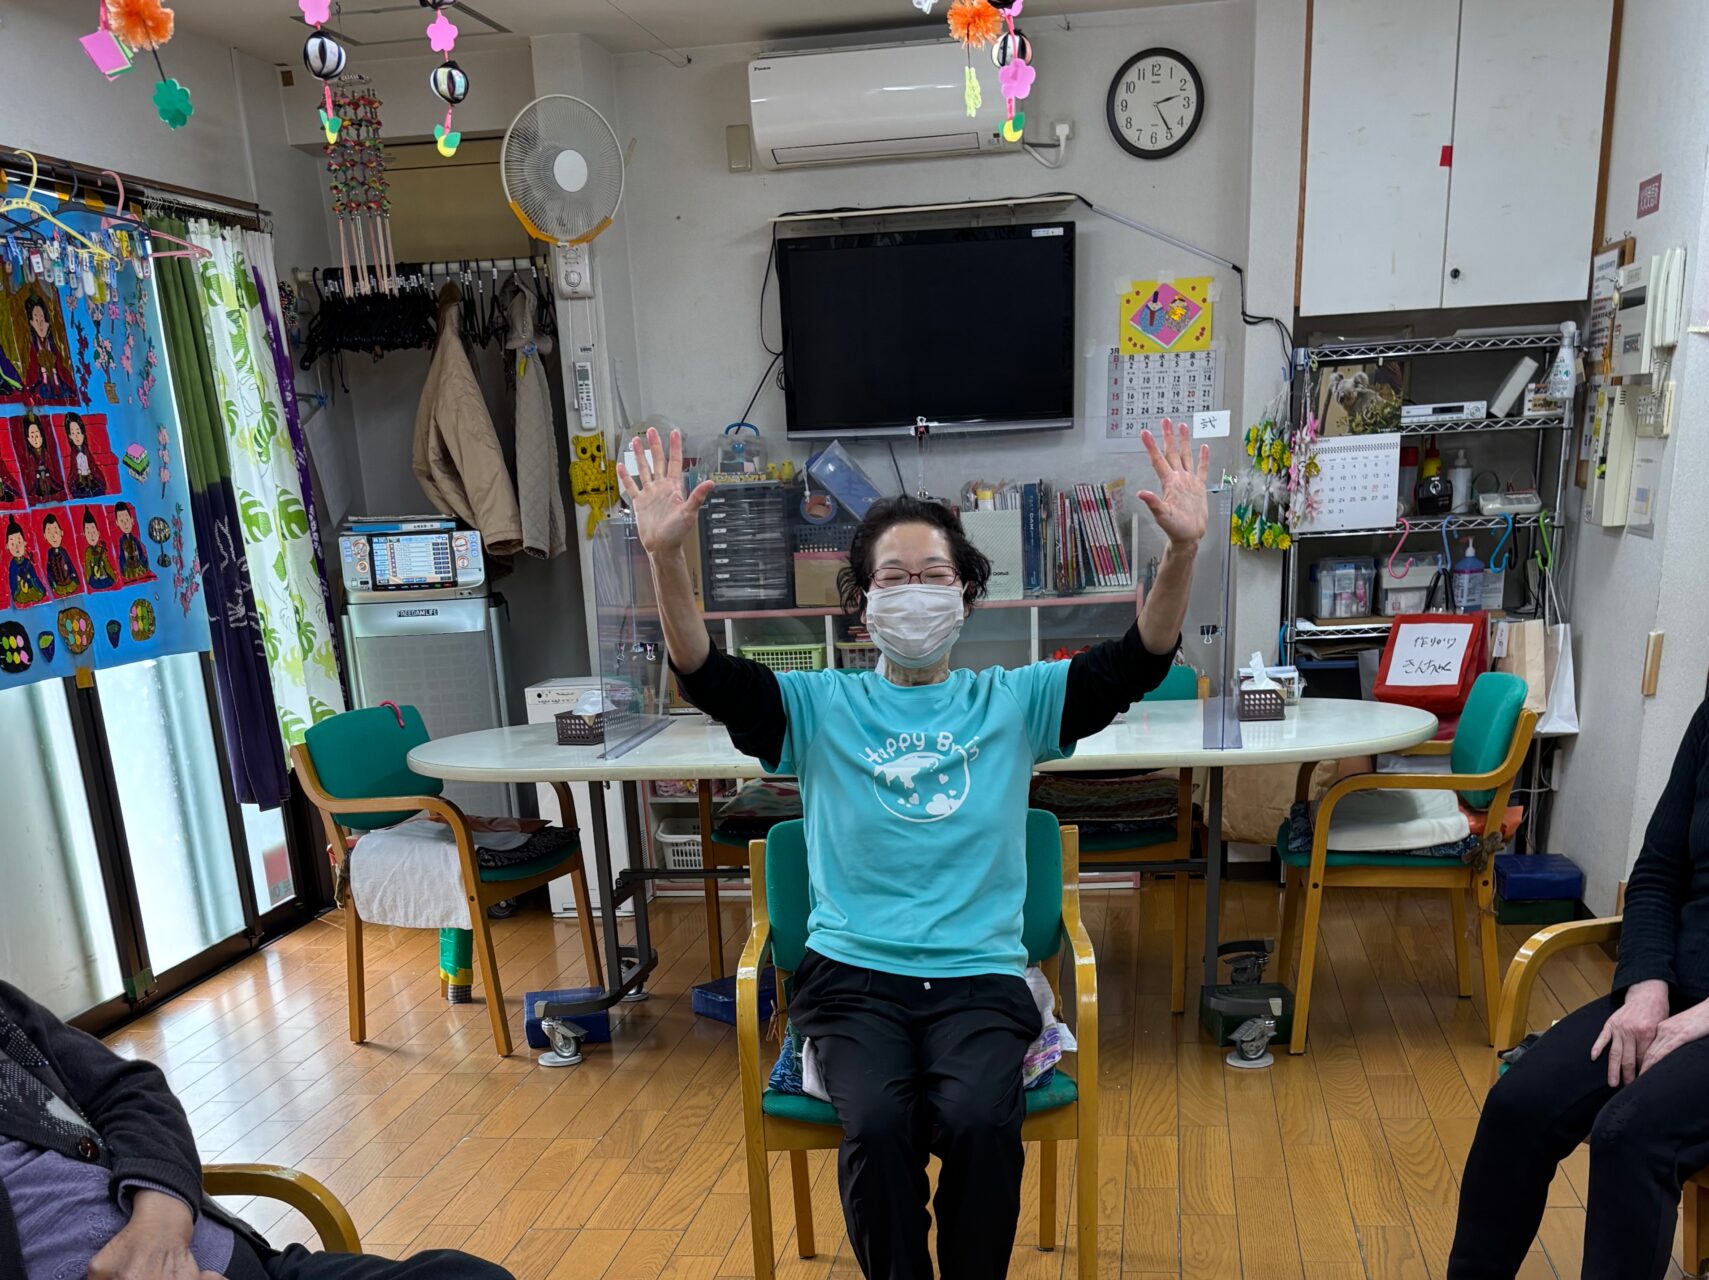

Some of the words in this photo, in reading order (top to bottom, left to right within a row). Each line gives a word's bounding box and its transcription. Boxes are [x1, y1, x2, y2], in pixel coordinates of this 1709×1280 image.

[1137, 68, 1146, 81] 11
[1151, 63, 1162, 77] 12
[1170, 66, 1173, 80] 1
[1125, 80, 1136, 94] 10
[1179, 78, 1187, 92] 2
[1120, 99, 1128, 112] 9
[1182, 96, 1190, 109] 3
[1125, 117, 1132, 129] 8
[1177, 115, 1184, 128] 4
[1136, 129, 1143, 142] 7
[1150, 131, 1158, 144] 6
[1165, 127, 1173, 140] 5
[1173, 375, 1181, 383] 12
[1204, 374, 1211, 382] 14
[1112, 393, 1120, 401] 15
[1142, 392, 1150, 400] 17
[1157, 391, 1165, 399] 18
[1111, 408, 1119, 416] 22
[1141, 407, 1149, 415] 24
[1156, 406, 1165, 414] 25
[1110, 423, 1119, 431] 29
[1126, 422, 1134, 430] 30
[857, 732, 925, 763] Happy
